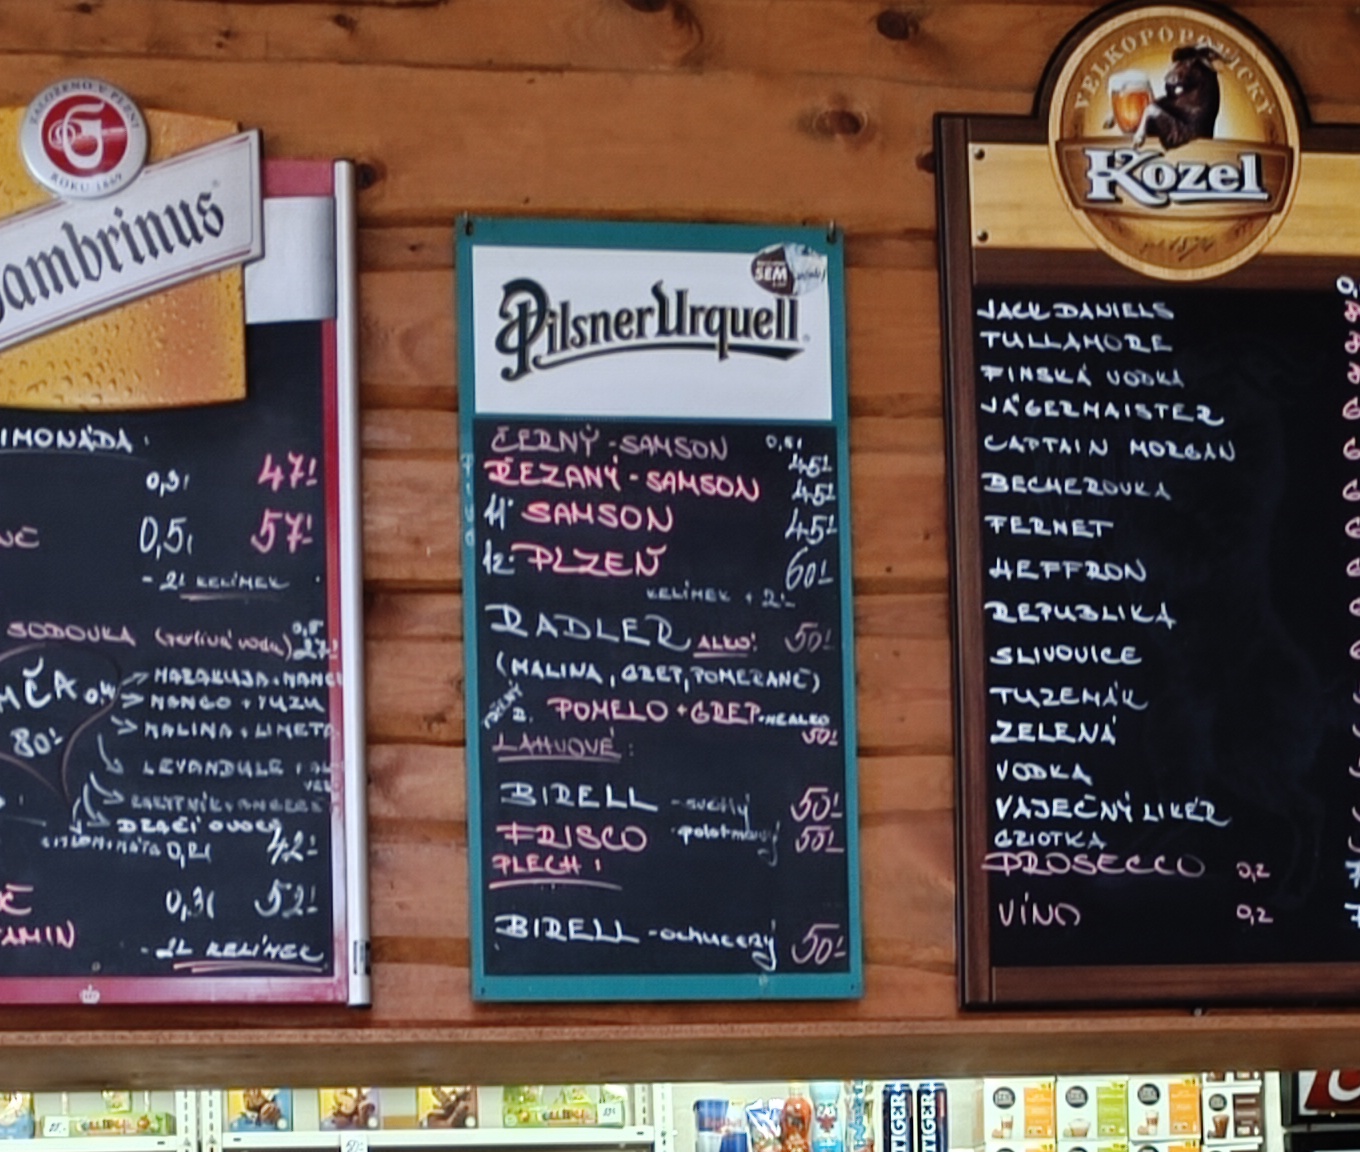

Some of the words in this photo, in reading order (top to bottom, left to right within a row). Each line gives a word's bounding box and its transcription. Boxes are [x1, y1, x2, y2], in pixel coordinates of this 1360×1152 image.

[1084, 148, 1269, 206] Kozel
[495, 277, 653, 381] Pilsner
[651, 281, 798, 362] Urquell
[980, 331, 1172, 353] TULLAMORE
[984, 434, 1108, 456] CAPTAIN
[1130, 440, 1235, 462] MORGAN
[981, 472, 1171, 501] BECHEROVKA
[522, 502, 673, 533] SAMSON
[984, 516, 1114, 538] FERNET
[989, 558, 1146, 581] HEFFRON
[485, 605, 690, 651] RADLER
[984, 601, 1176, 629] REPUBLIKA
[989, 646, 1141, 665] SLIVOVICE
[548, 697, 668, 722] POMELO
[997, 760, 1092, 785] VODKA
[496, 822, 647, 851] FRISCO
[981, 851, 1205, 876] PROSECCO
